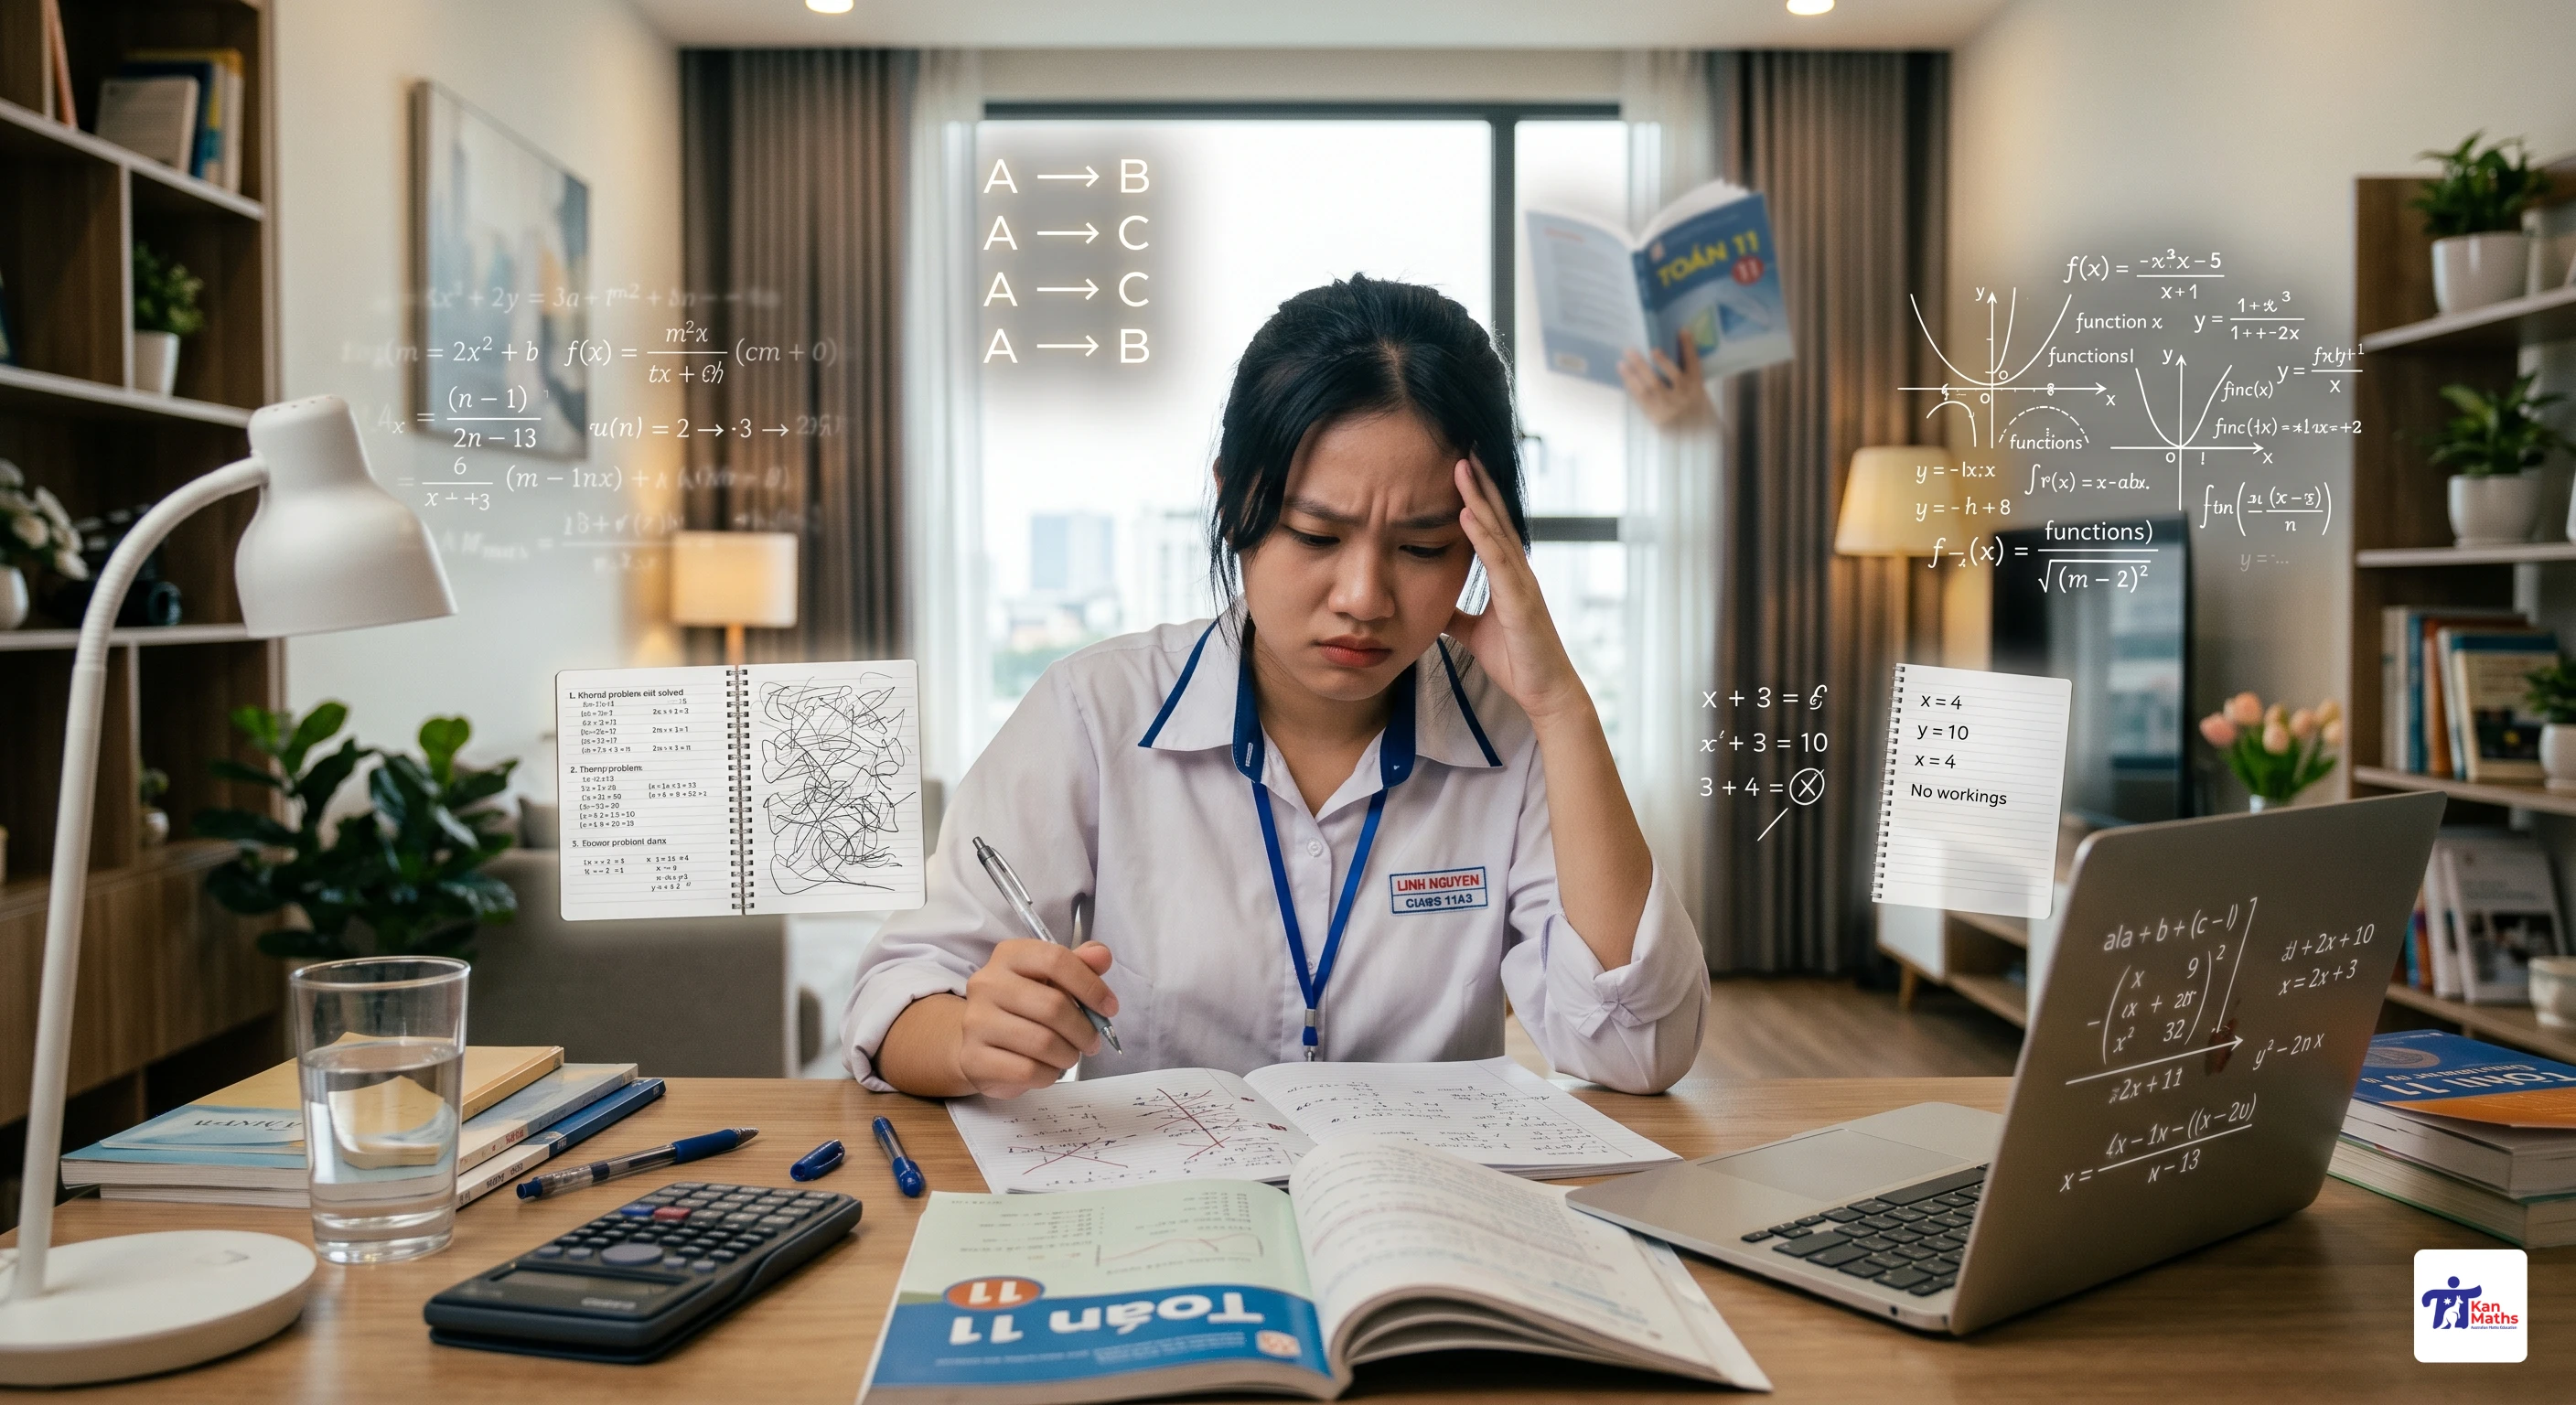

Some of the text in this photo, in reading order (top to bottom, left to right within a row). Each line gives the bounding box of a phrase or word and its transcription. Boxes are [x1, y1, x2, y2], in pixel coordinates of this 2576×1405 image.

[1658, 241, 1728, 287] TOÁN
[1733, 231, 1759, 256] 11
[1951, 695, 1962, 710] 4
[1917, 725, 1927, 739] y
[1948, 725, 1969, 740] 10
[1945, 755, 1956, 768] 4
[1911, 784, 2007, 808] No workings
[1398, 874, 1480, 891] LINH NGUYEN
[1445, 894, 1473, 906] 11A3
[968, 1281, 1023, 1304] 11
[949, 1292, 1264, 1345] Toán 11
